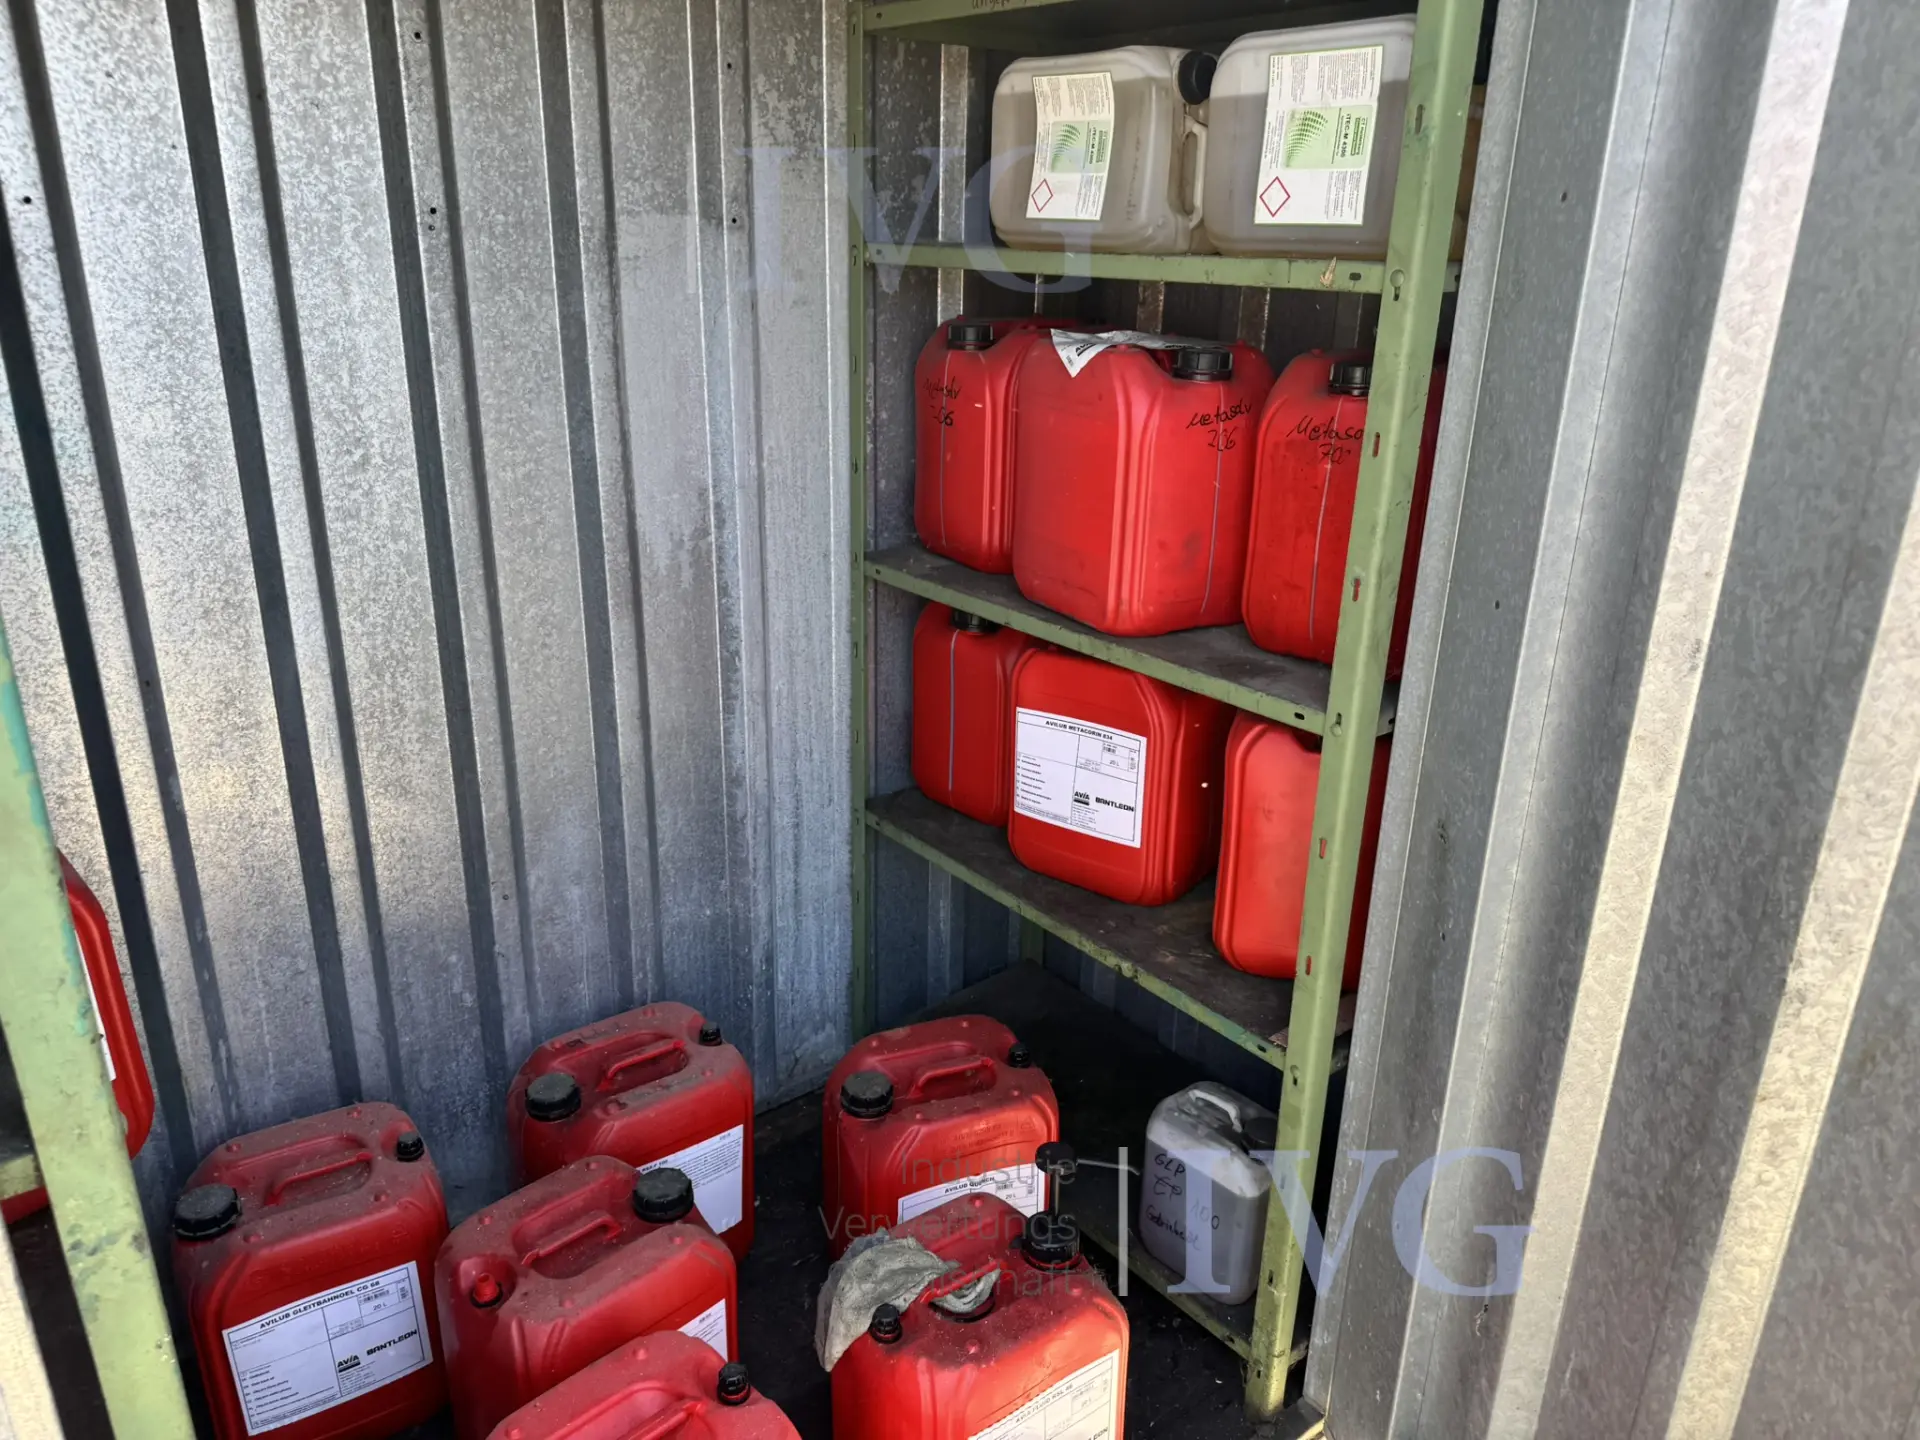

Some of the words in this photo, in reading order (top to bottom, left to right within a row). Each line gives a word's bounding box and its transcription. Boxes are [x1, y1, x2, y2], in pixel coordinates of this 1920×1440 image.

[1045, 720, 1068, 730] AVILUB
[1074, 791, 1090, 800] AVIA
[1095, 797, 1134, 812] BANTLEON
[259, 1313, 291, 1329] AVILUB
[292, 1290, 355, 1314] GLEITBAHNOEL
[372, 1303, 383, 1311] 20
[336, 1355, 360, 1369] AVIA
[366, 1329, 418, 1356] BANTLEON
